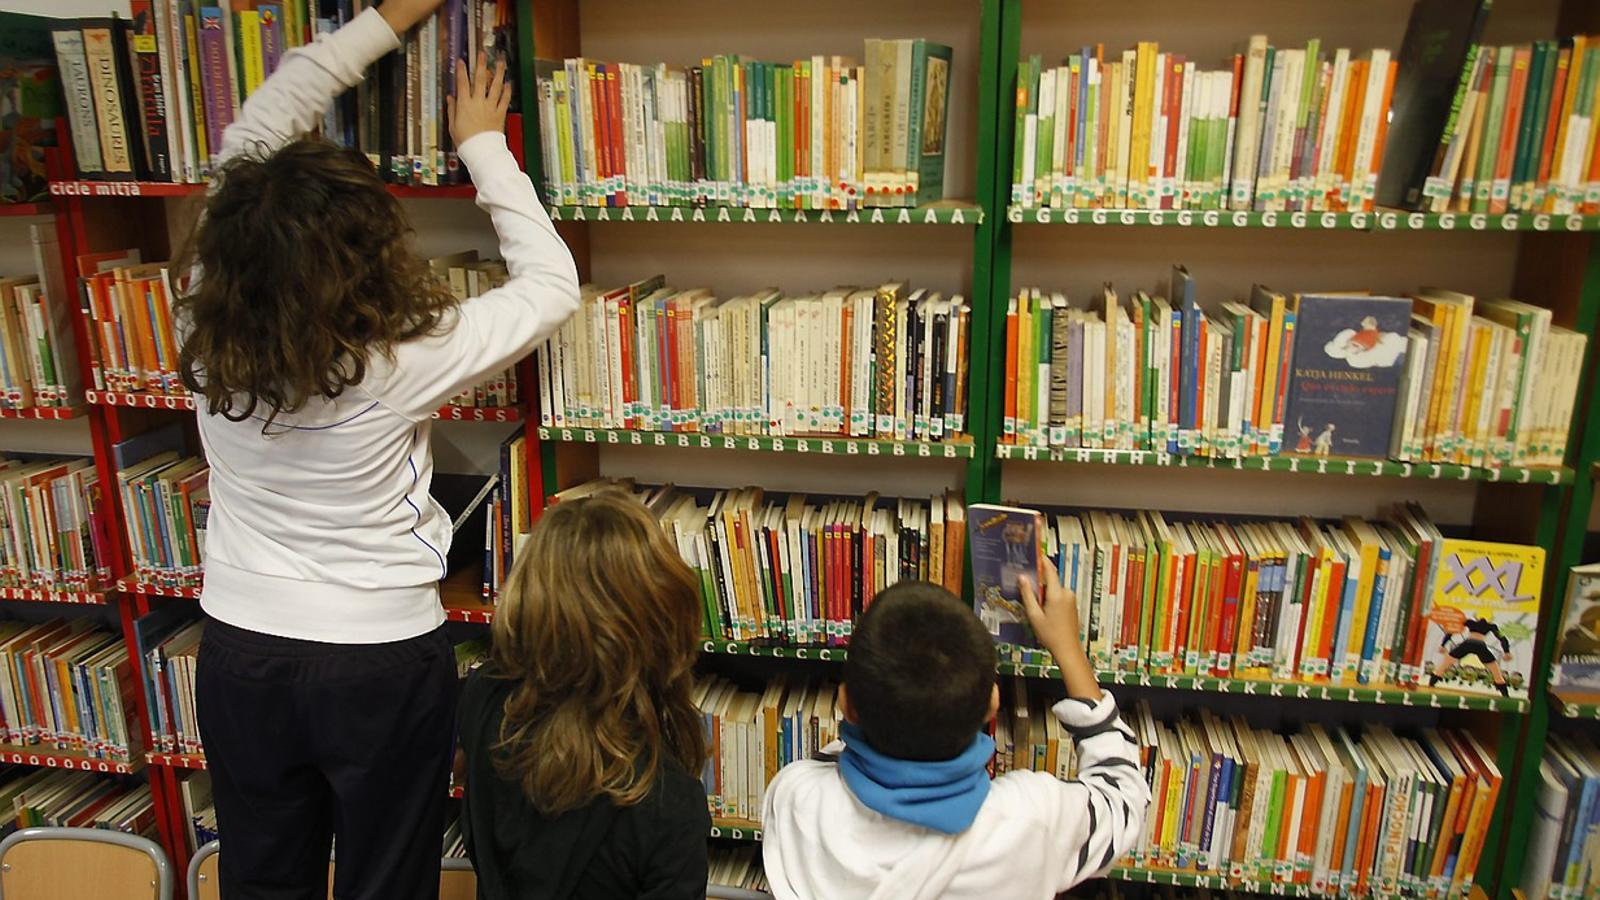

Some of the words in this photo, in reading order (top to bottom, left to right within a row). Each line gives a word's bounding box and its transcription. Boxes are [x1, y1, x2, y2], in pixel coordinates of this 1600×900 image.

[71, 61, 95, 128] TAURONS
[99, 58, 127, 164] DINOSAURES
[51, 181, 91, 196] cicle
[551, 207, 562, 220] A
[574, 207, 586, 220] A
[598, 208, 610, 220] A
[622, 207, 634, 221] A
[646, 207, 659, 221] A
[671, 208, 683, 221] A
[693, 208, 705, 221] A
[718, 208, 730, 221] A
[743, 208, 756, 222] A
[769, 209, 782, 222] A
[794, 209, 807, 222] A
[820, 209, 833, 223] A
[847, 210, 859, 223] A
[871, 208, 884, 223] A
[898, 208, 911, 223] A
[925, 208, 938, 223] A
[951, 208, 965, 223] A
[1009, 207, 1023, 223] G
[1036, 208, 1050, 223] G
[1064, 208, 1078, 224] G
[1092, 209, 1107, 224] G
[1120, 210, 1135, 225] G
[1149, 210, 1163, 225] G
[1177, 210, 1192, 225] G
[1203, 210, 1218, 226] G
[1232, 211, 1248, 227] G
[1262, 211, 1277, 227] G
[1291, 212, 1306, 228] G
[1321, 212, 1336, 228] G
[1351, 212, 1366, 229] G
[1381, 213, 1397, 229] G
[1408, 213, 1425, 229] G
[1438, 213, 1455, 229] G
[1470, 213, 1486, 230] G
[1501, 214, 1518, 230] G
[1533, 214, 1550, 230] G
[1566, 214, 1582, 231] G
[34, 408, 43, 419] L
[54, 409, 62, 420] L
[452, 407, 462, 420] S
[474, 408, 484, 421] S
[496, 410, 506, 422] S
[562, 429, 573, 441] B
[584, 430, 595, 442] B
[607, 431, 618, 443] B
[631, 432, 642, 444] B
[655, 433, 665, 446] B
[678, 434, 689, 447] B
[701, 435, 711, 448] B
[724, 436, 735, 449] B
[749, 437, 760, 450] B
[773, 438, 784, 451] B
[797, 439, 809, 452] B
[822, 440, 833, 453] B
[847, 441, 858, 454] B
[868, 442, 879, 455] B
[894, 443, 905, 456] B
[919, 444, 930, 456] B
[944, 445, 956, 458] B
[996, 445, 1011, 459] H
[1024, 446, 1038, 460] H
[1050, 448, 1064, 461] H
[1077, 449, 1090, 462] H
[1104, 450, 1117, 464] H
[1131, 451, 1144, 465] H
[1157, 452, 1171, 466] H
[1371, 461, 1383, 476] J
[1399, 463, 1411, 477] J
[1430, 464, 1441, 478] J
[1459, 466, 1470, 480] J
[1489, 467, 1500, 481] J
[1519, 470, 1530, 483] J
[1548, 471, 1560, 485] J
[1443, 553, 1536, 603] XXL
[13, 588, 24, 599] M
[31, 590, 42, 601] M
[49, 591, 61, 602] M
[67, 592, 79, 603] M
[85, 594, 96, 604] M
[116, 580, 127, 592] S
[136, 582, 146, 593] S
[155, 585, 164, 595] S
[174, 587, 183, 597] S
[192, 588, 201, 598] S
[462, 611, 471, 622] T
[483, 612, 492, 623] T
[704, 641, 714, 652] C
[727, 643, 738, 654] C
[796, 648, 807, 659] C
[820, 649, 831, 661] C
[1014, 664, 1024, 676] K
[1040, 666, 1050, 678] K
[1114, 670, 1125, 684] K
[1140, 673, 1151, 686] K
[1166, 675, 1178, 688] K
[1192, 678, 1204, 691] K
[1218, 679, 1230, 693] K
[1244, 681, 1257, 695] K
[1270, 683, 1283, 697] K
[1297, 685, 1310, 698] K
[1321, 687, 1331, 700] L
[1348, 688, 1358, 701] L
[1375, 690, 1385, 704] L
[1403, 692, 1413, 705] L
[1431, 694, 1441, 707] L
[1459, 696, 1469, 709] L
[1565, 703, 1579, 717] S
[13, 754, 22, 763] O
[30, 756, 39, 765] O
[47, 757, 57, 767] O
[64, 759, 74, 768] O
[81, 761, 91, 770] O
[99, 762, 108, 772] O
[116, 764, 125, 773] O
[145, 753, 155, 763] T
[163, 756, 172, 766] T
[181, 758, 190, 768] T
[199, 760, 207, 770] T
[711, 827, 721, 838] D
[733, 829, 743, 839] D
[1123, 868, 1133, 880] L
[1147, 871, 1157, 883] L
[1171, 873, 1181, 885] L
[1195, 875, 1210, 888] M
[1245, 879, 1260, 893] M
[1270, 882, 1285, 896] M
[1296, 884, 1310, 898] M
